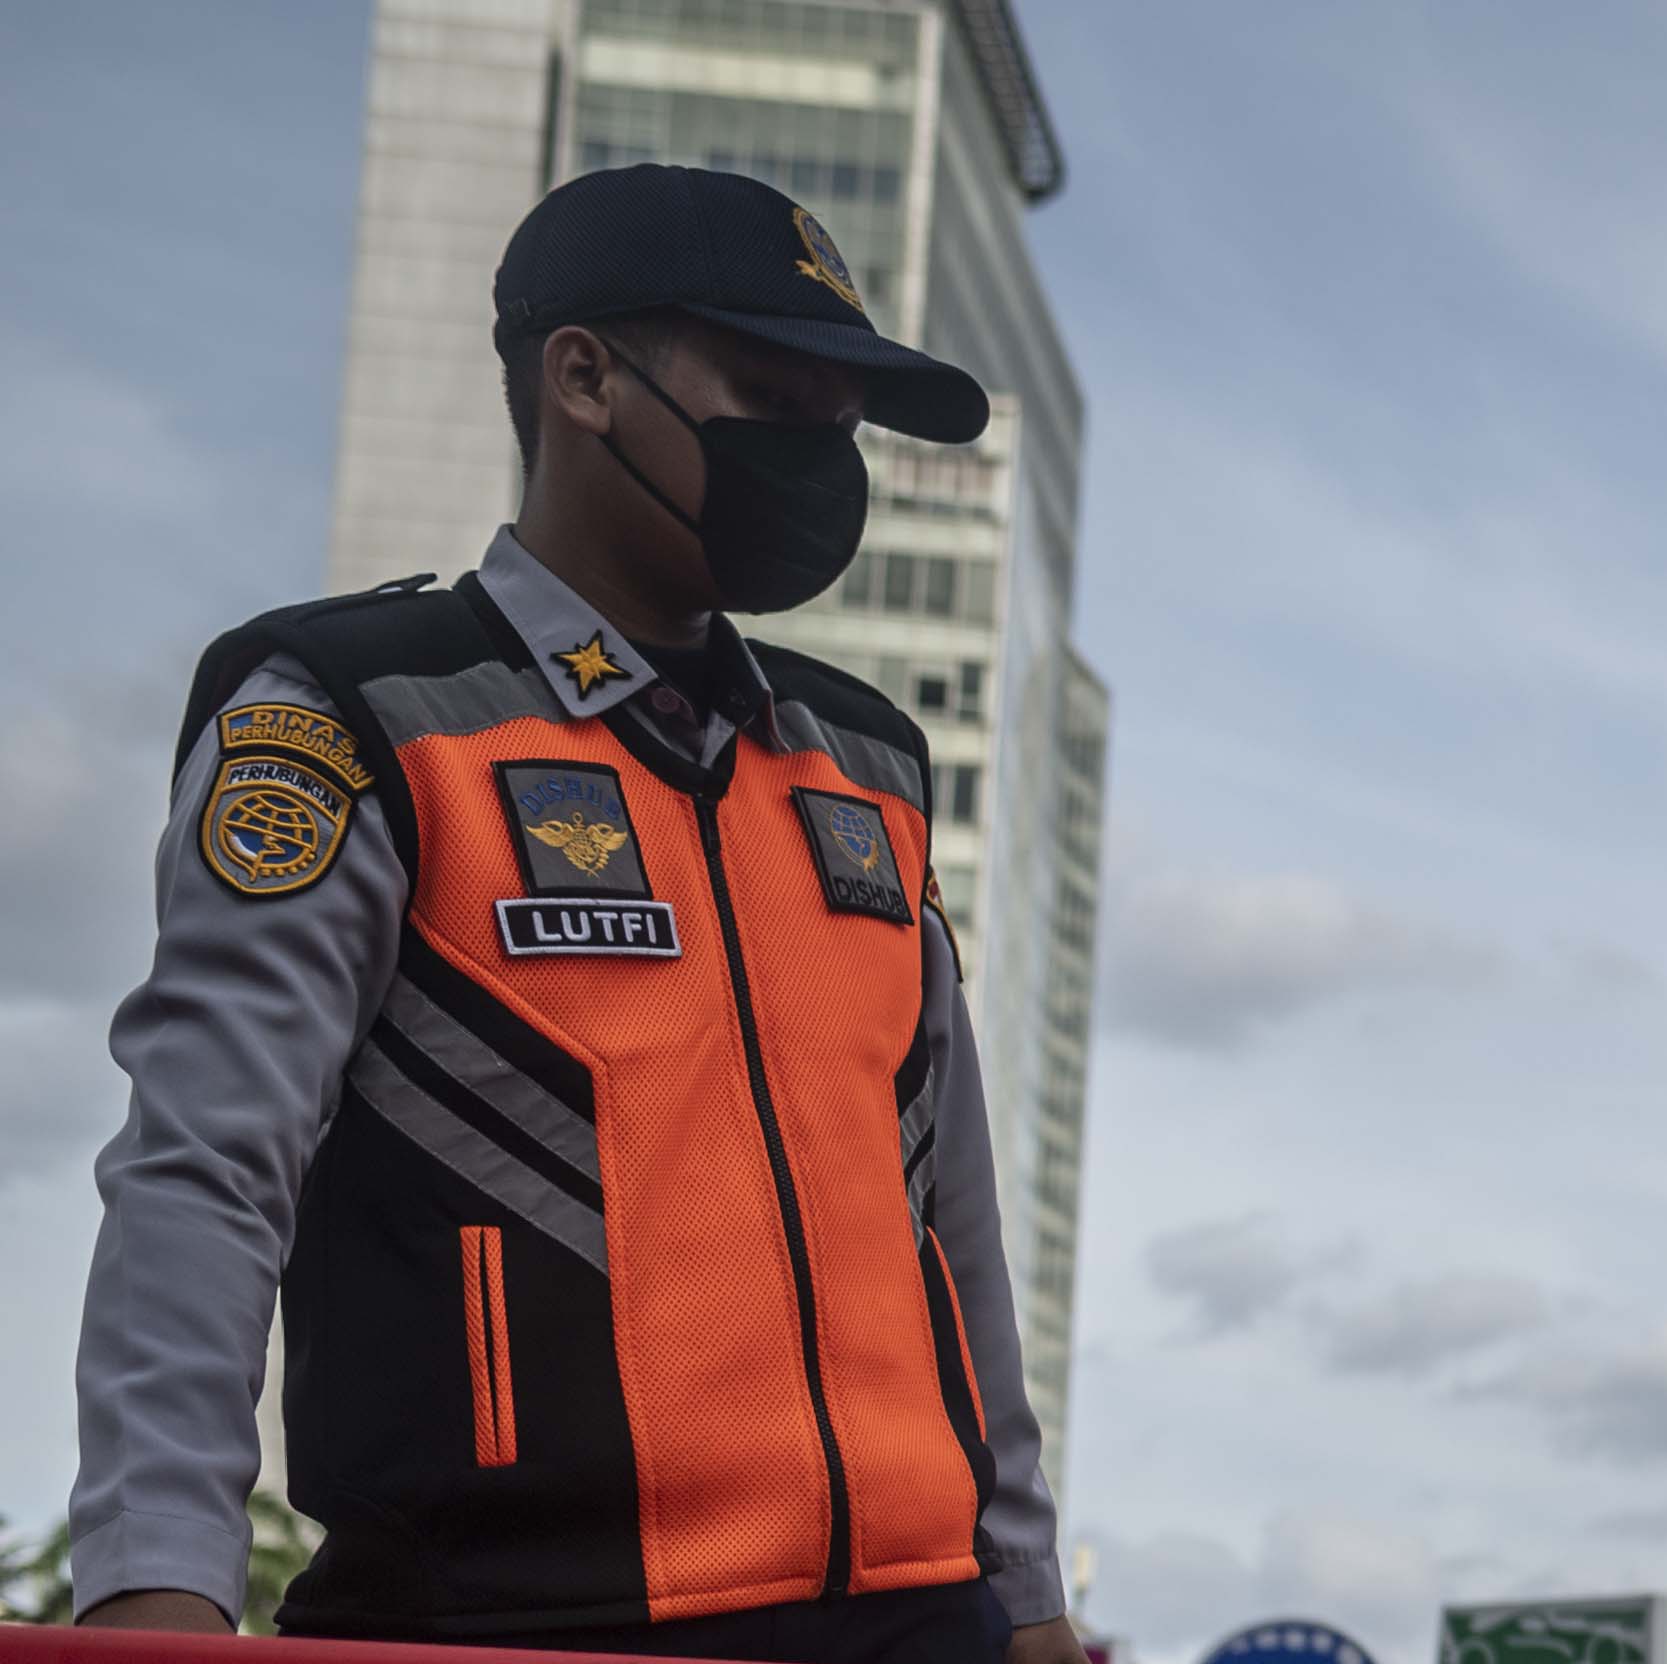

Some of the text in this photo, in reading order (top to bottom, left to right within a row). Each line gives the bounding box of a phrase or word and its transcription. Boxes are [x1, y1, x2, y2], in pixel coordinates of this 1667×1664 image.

[231, 724, 367, 781] PERHUBUNGAN
[252, 711, 359, 755] DINAS
[228, 765, 342, 814] PERHUBUNGAN
[520, 775, 622, 820] DISHUB
[833, 876, 908, 914] DISHUB
[532, 911, 657, 943] LUTFI
